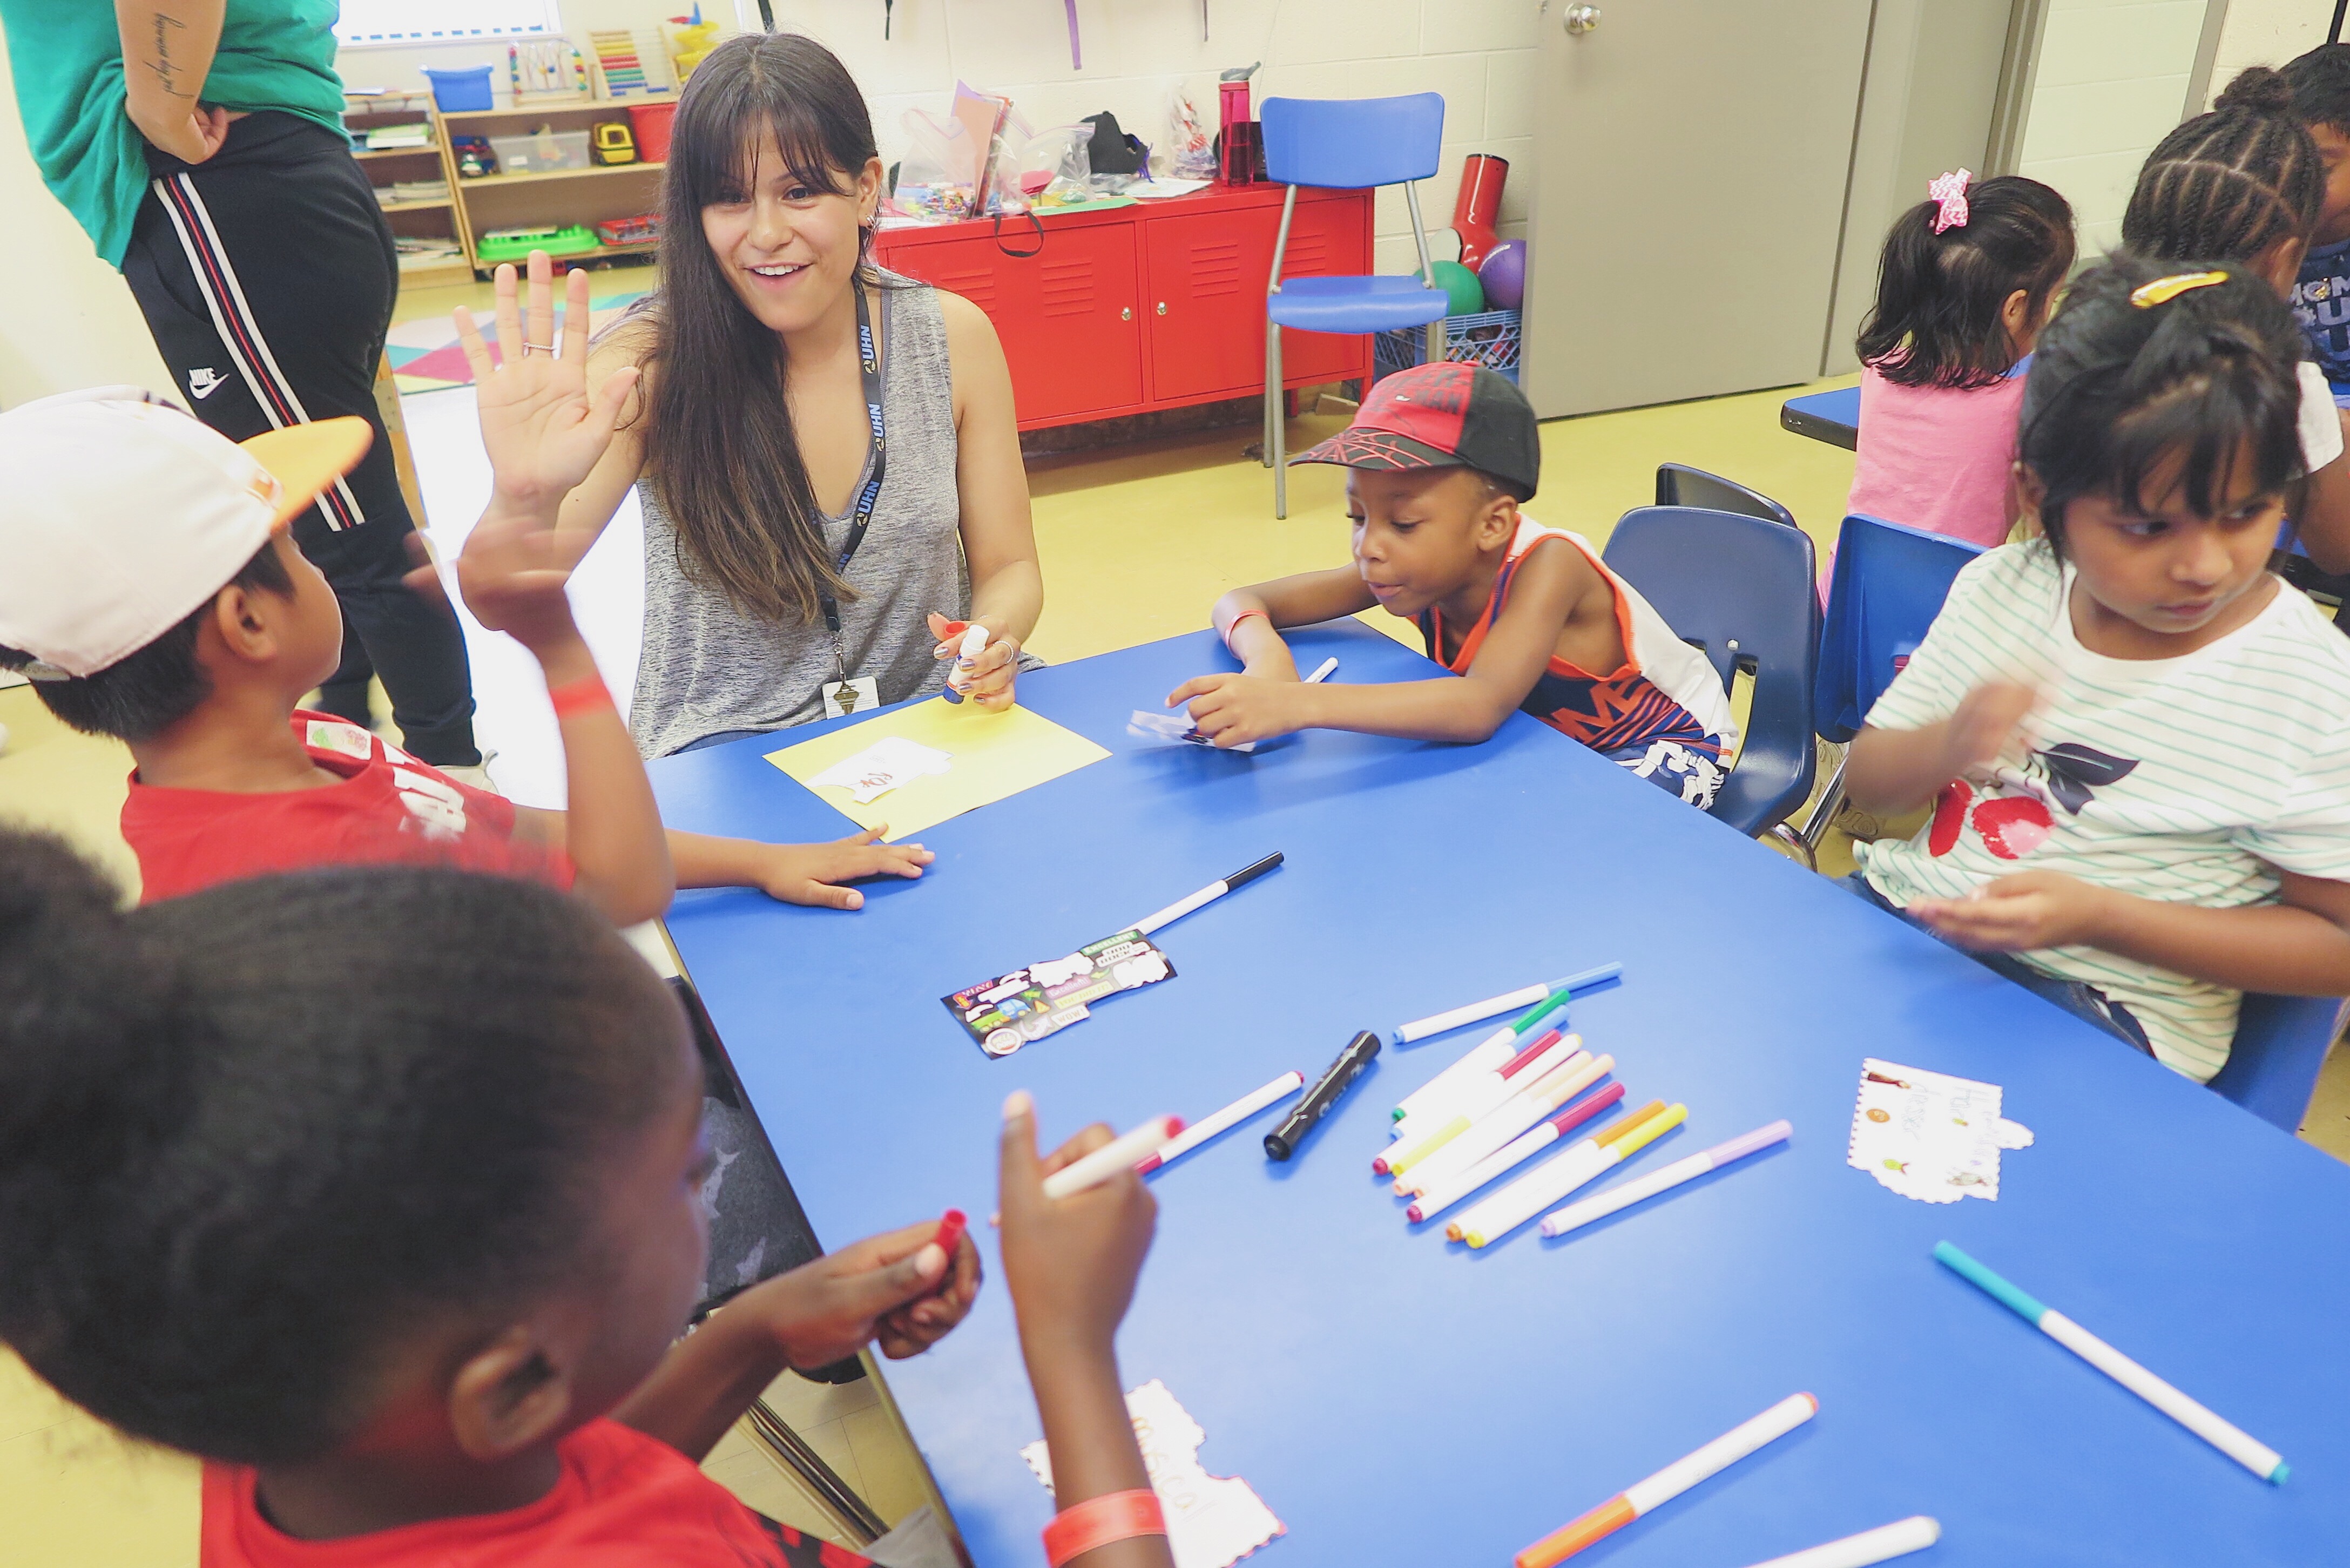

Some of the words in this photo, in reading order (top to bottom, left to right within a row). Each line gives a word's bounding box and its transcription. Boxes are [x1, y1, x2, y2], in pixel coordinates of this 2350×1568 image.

[860, 325, 874, 360] UHN
[189, 367, 217, 387] NIKE
[868, 403, 884, 437] UHN
[857, 481, 880, 513] UHN
[836, 553, 851, 575] HN
[1084, 931, 1135, 955] EXCELLENT
[1057, 1008, 1086, 1023] WOW!
